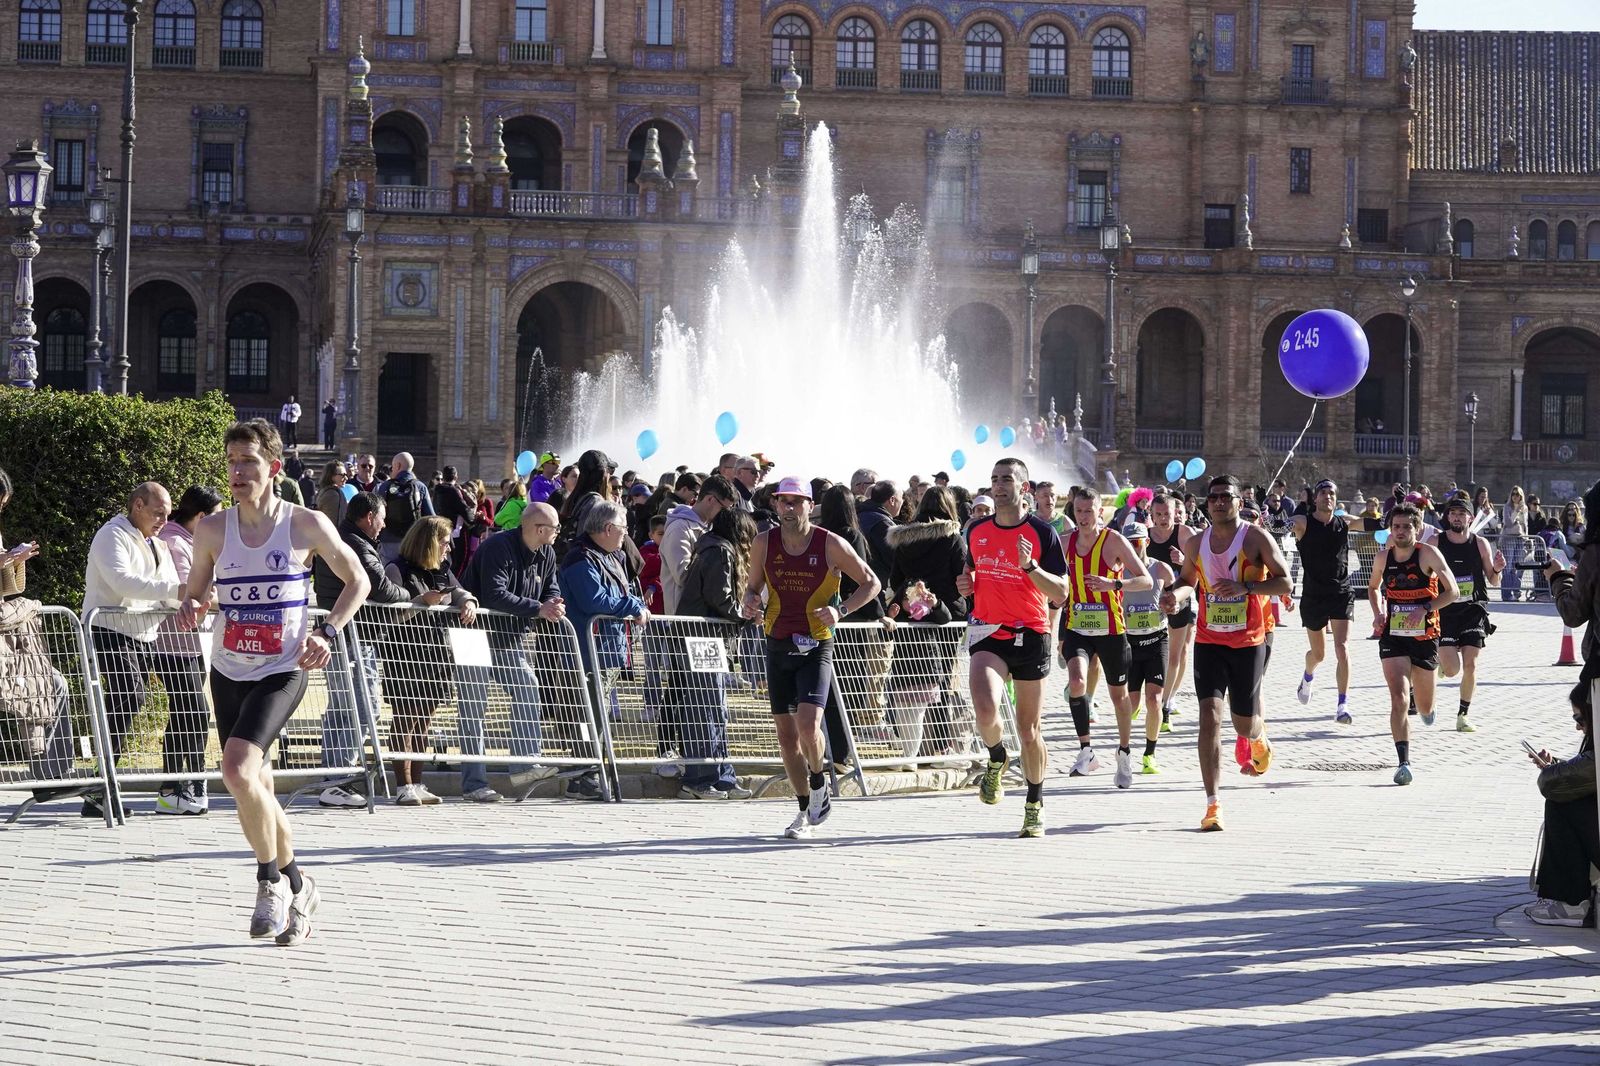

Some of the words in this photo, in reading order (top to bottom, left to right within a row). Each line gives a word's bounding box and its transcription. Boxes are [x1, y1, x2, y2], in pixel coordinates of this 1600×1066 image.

[1294, 327, 1320, 351] 2:45
[230, 587, 241, 601] C
[248, 586, 260, 600] &
[267, 585, 279, 599] C
[242, 613, 275, 622] ZURICH
[1212, 615, 1238, 624] ARJUN
[244, 628, 258, 637] 867
[236, 639, 265, 653] AXEL
